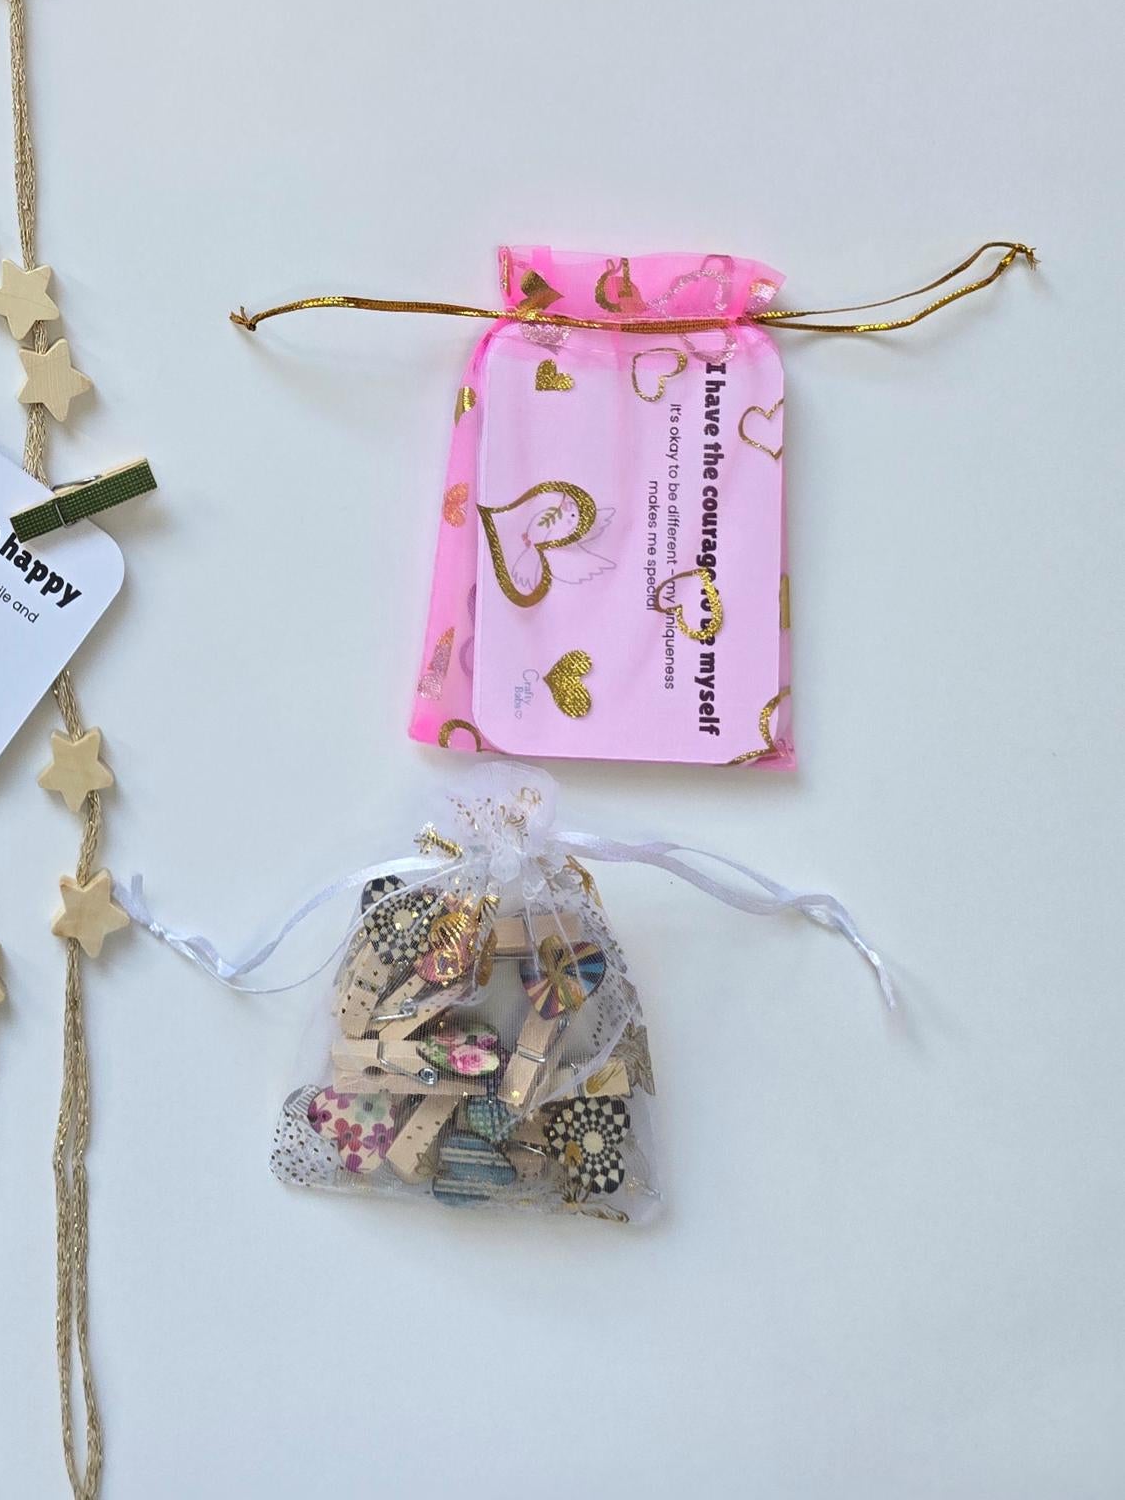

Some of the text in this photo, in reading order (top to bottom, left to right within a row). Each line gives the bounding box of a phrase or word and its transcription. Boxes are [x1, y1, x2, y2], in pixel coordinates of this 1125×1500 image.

[706, 361, 727, 374] I
[669, 403, 682, 423] It's
[703, 379, 726, 437] have
[664, 425, 681, 461] okay
[667, 463, 679, 479] to
[702, 441, 725, 480] the
[647, 479, 660, 528] makes
[667, 482, 680, 501] be
[646, 531, 657, 556] me
[666, 504, 681, 564] different
[662, 581, 677, 603] my
[11, 600, 40, 623] and
[693, 651, 720, 736] myself
